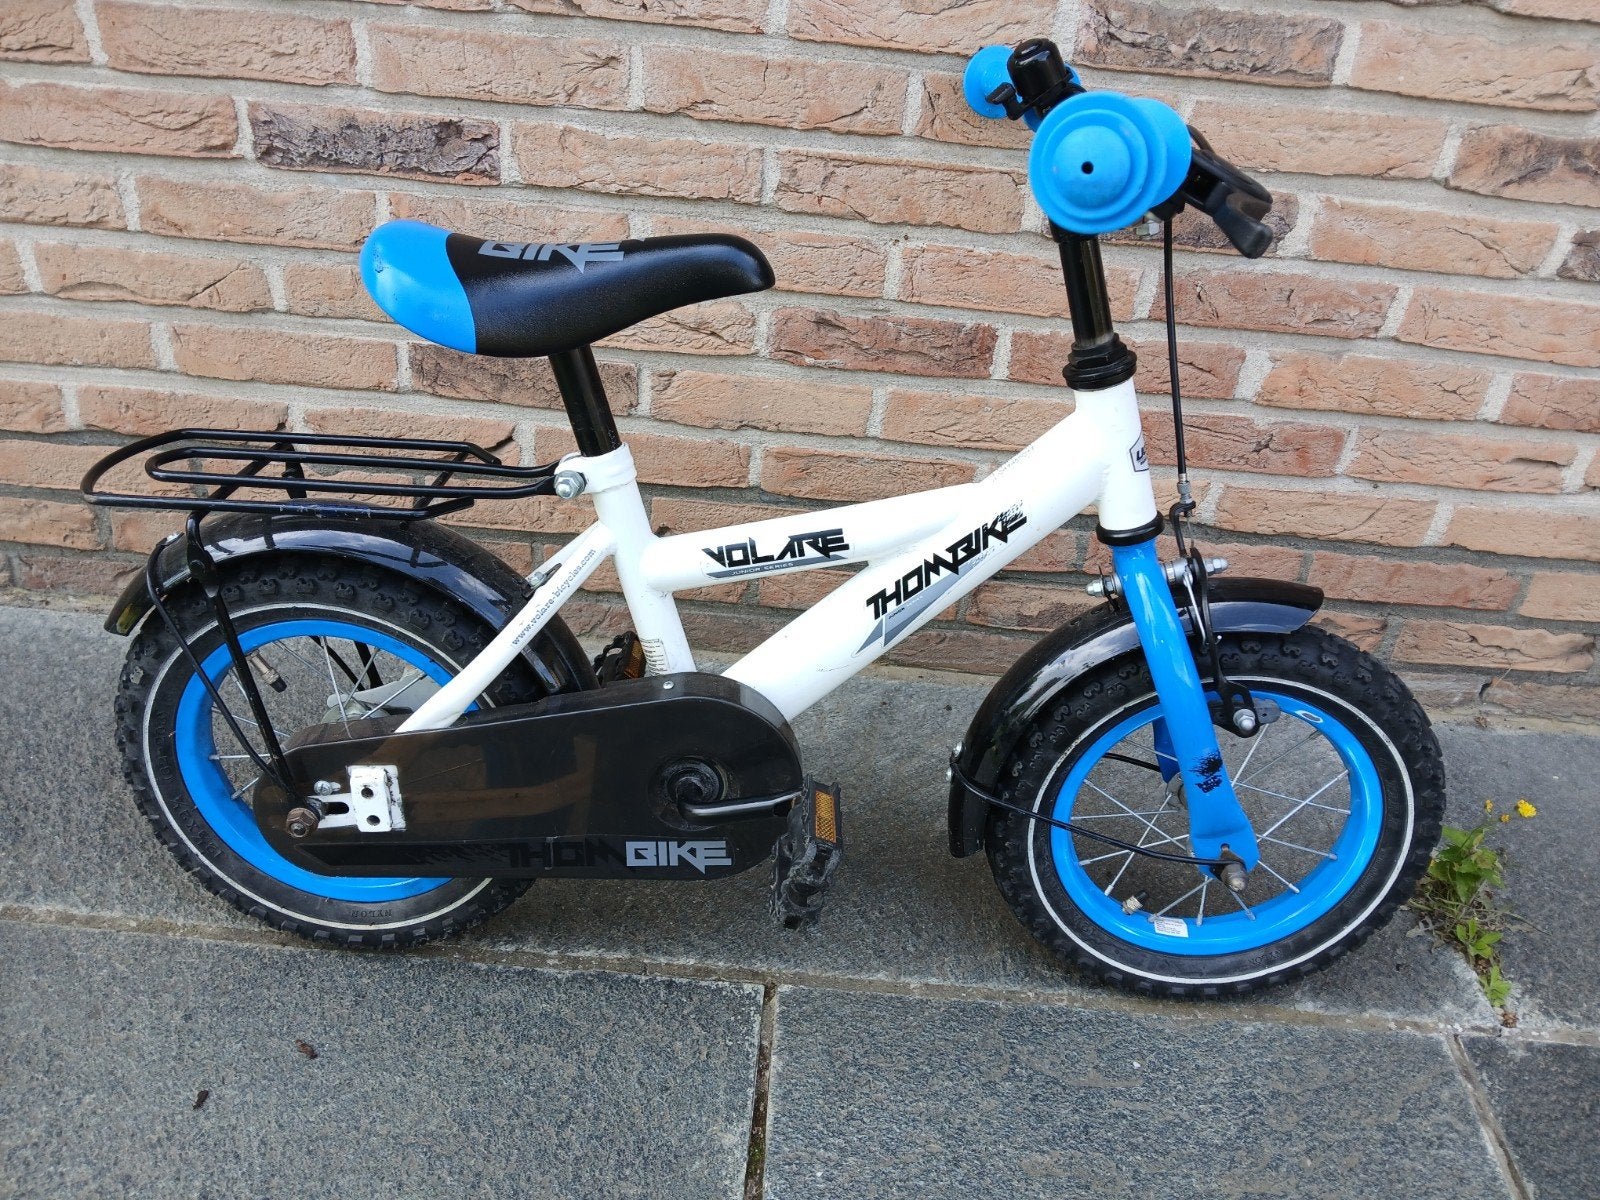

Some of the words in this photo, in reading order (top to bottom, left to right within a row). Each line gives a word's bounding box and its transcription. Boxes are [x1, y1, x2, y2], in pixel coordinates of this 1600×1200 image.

[478, 240, 625, 274] BIKE
[702, 528, 850, 568] VOLARE
[866, 508, 1027, 620] THOMBIKE
[731, 567, 761, 577] JUNIOR
[763, 562, 795, 571] SERIES
